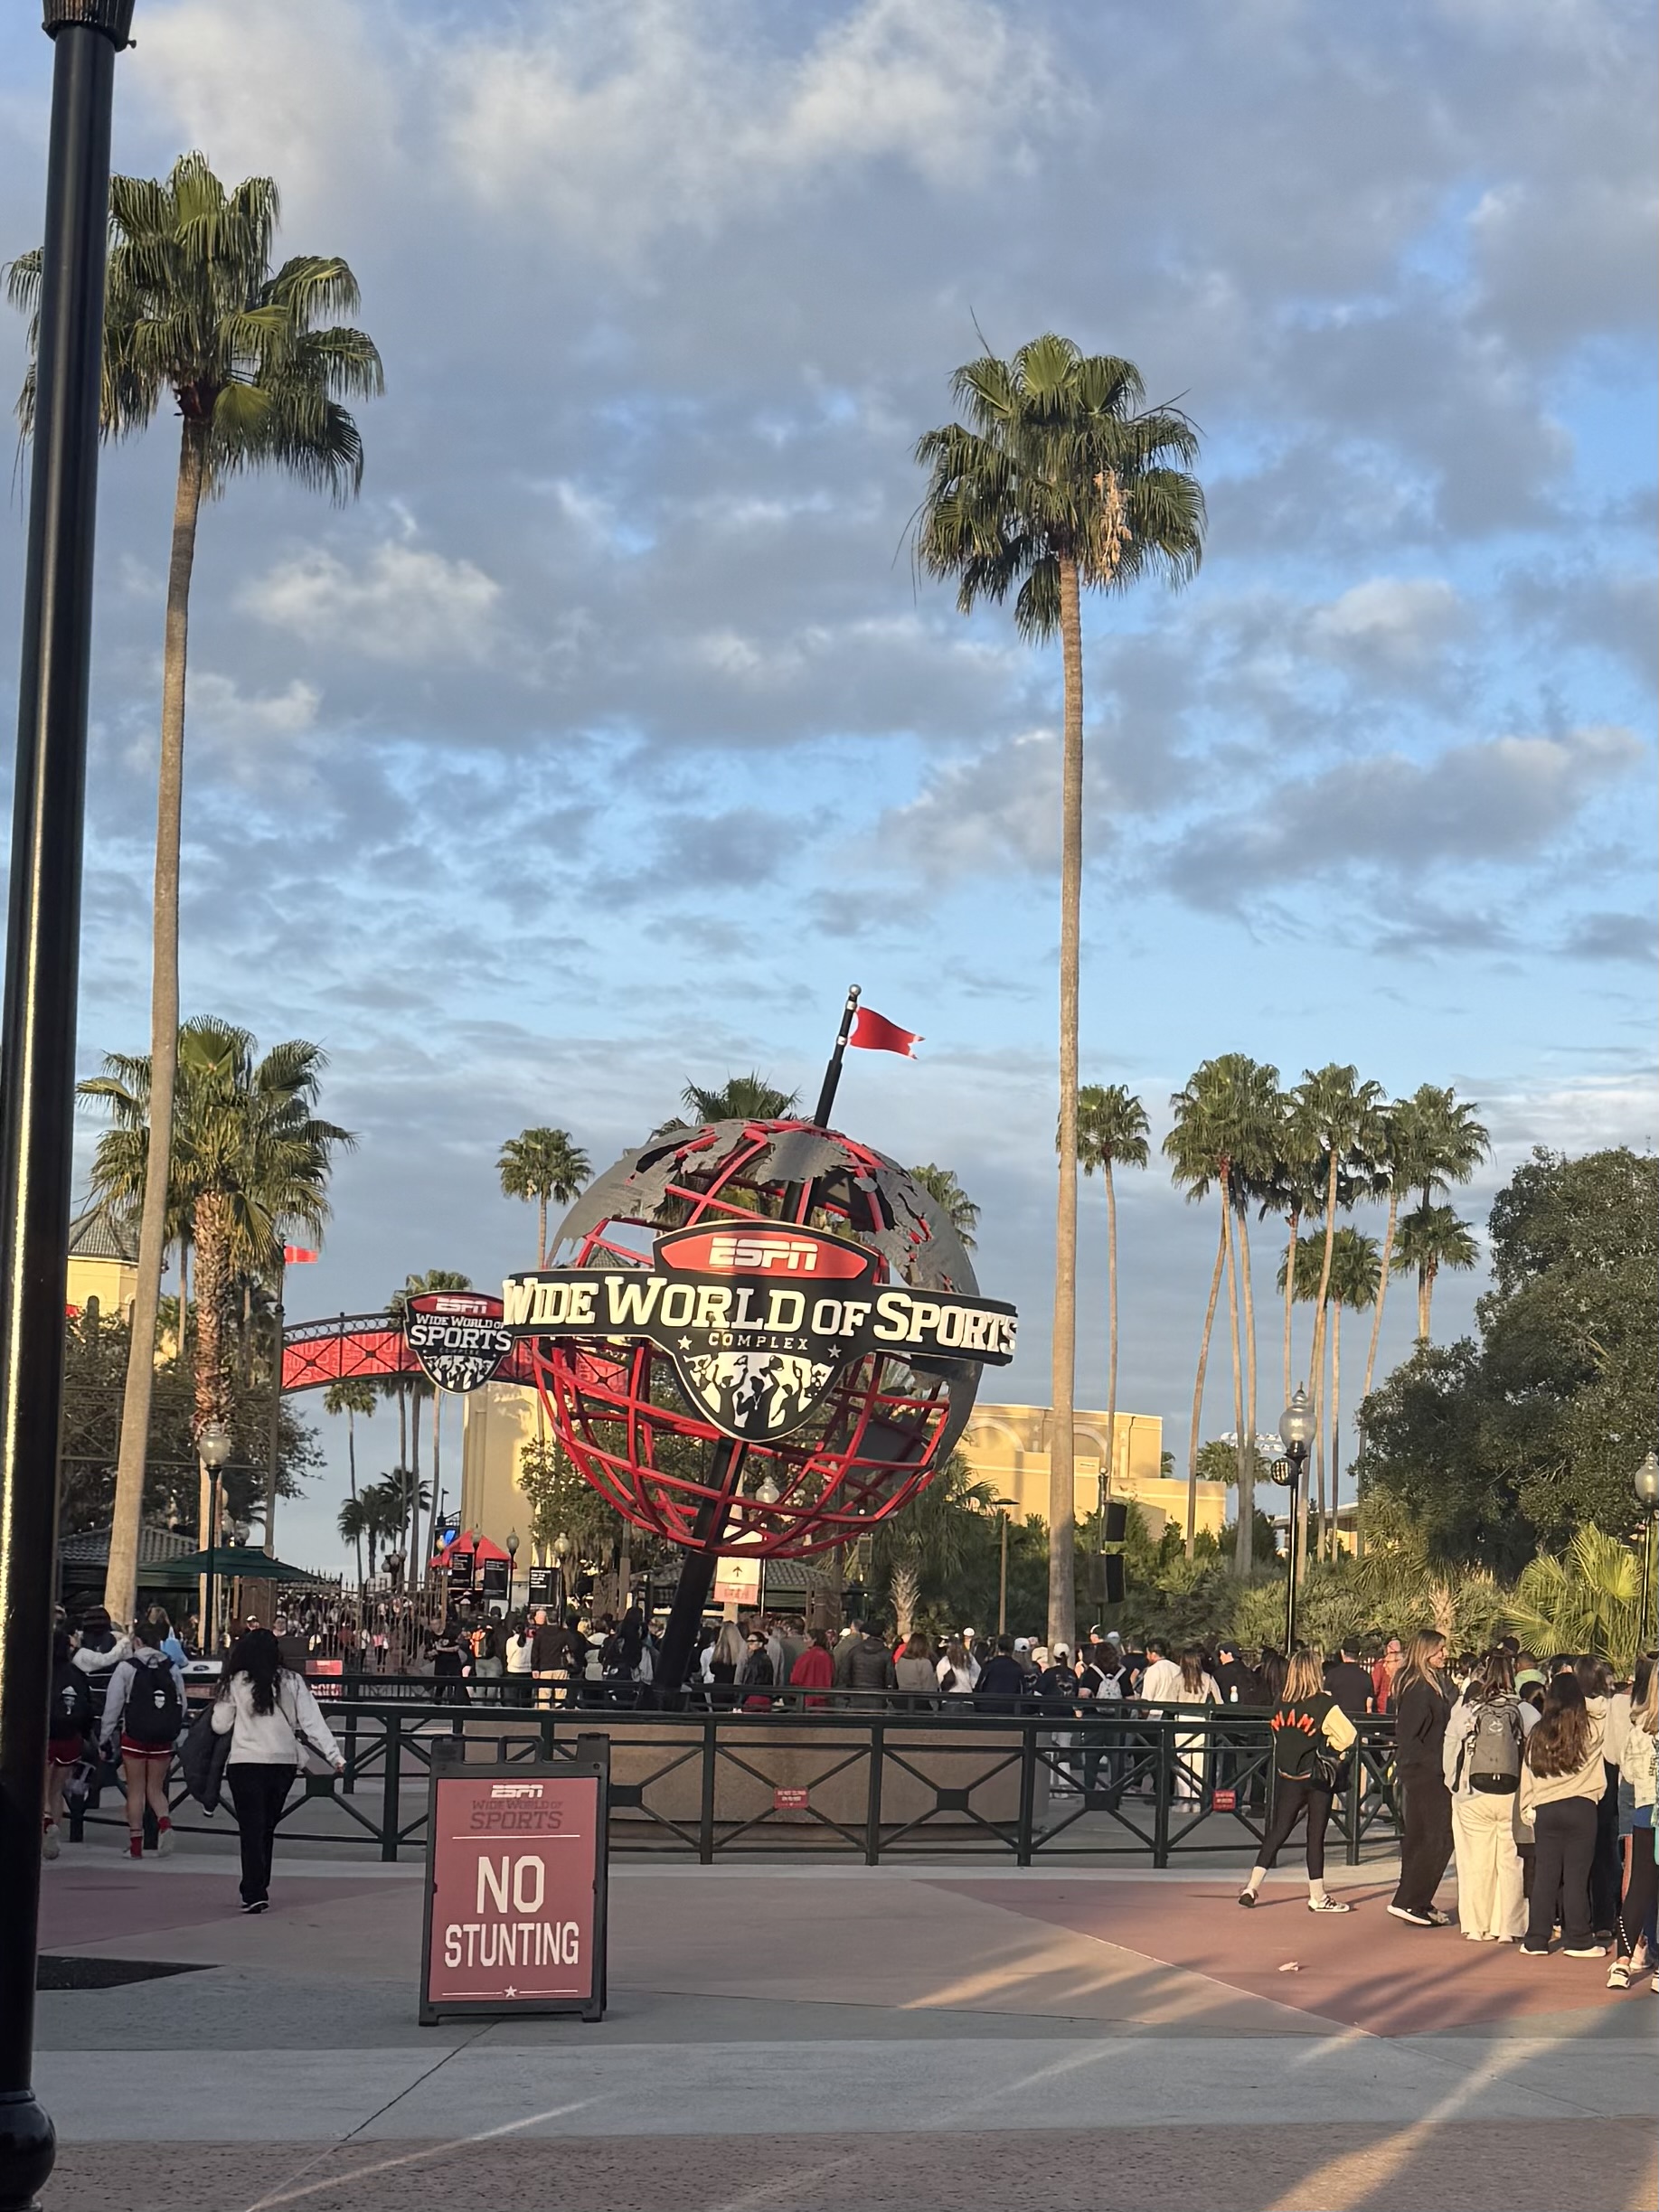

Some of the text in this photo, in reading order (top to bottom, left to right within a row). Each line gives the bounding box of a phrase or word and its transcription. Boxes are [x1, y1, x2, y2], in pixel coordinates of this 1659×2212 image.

[709, 1237, 818, 1271] ESPN
[436, 1297, 488, 1314] ESPN
[416, 1313, 449, 1325] WIDE
[451, 1316, 493, 1328] WORLD
[503, 1276, 1018, 1355] WIDE WORLD OF SPORTS
[410, 1325, 513, 1351] SPORTS
[708, 1332, 808, 1351] COMPLEX
[491, 1784, 543, 1798] ESPN
[473, 1800, 504, 1810] WIDE
[506, 1800, 550, 1810] WORLD
[470, 1811, 563, 1830] SPORTS
[476, 1855, 545, 1914] NO
[444, 1921, 580, 1968] STUNTING
